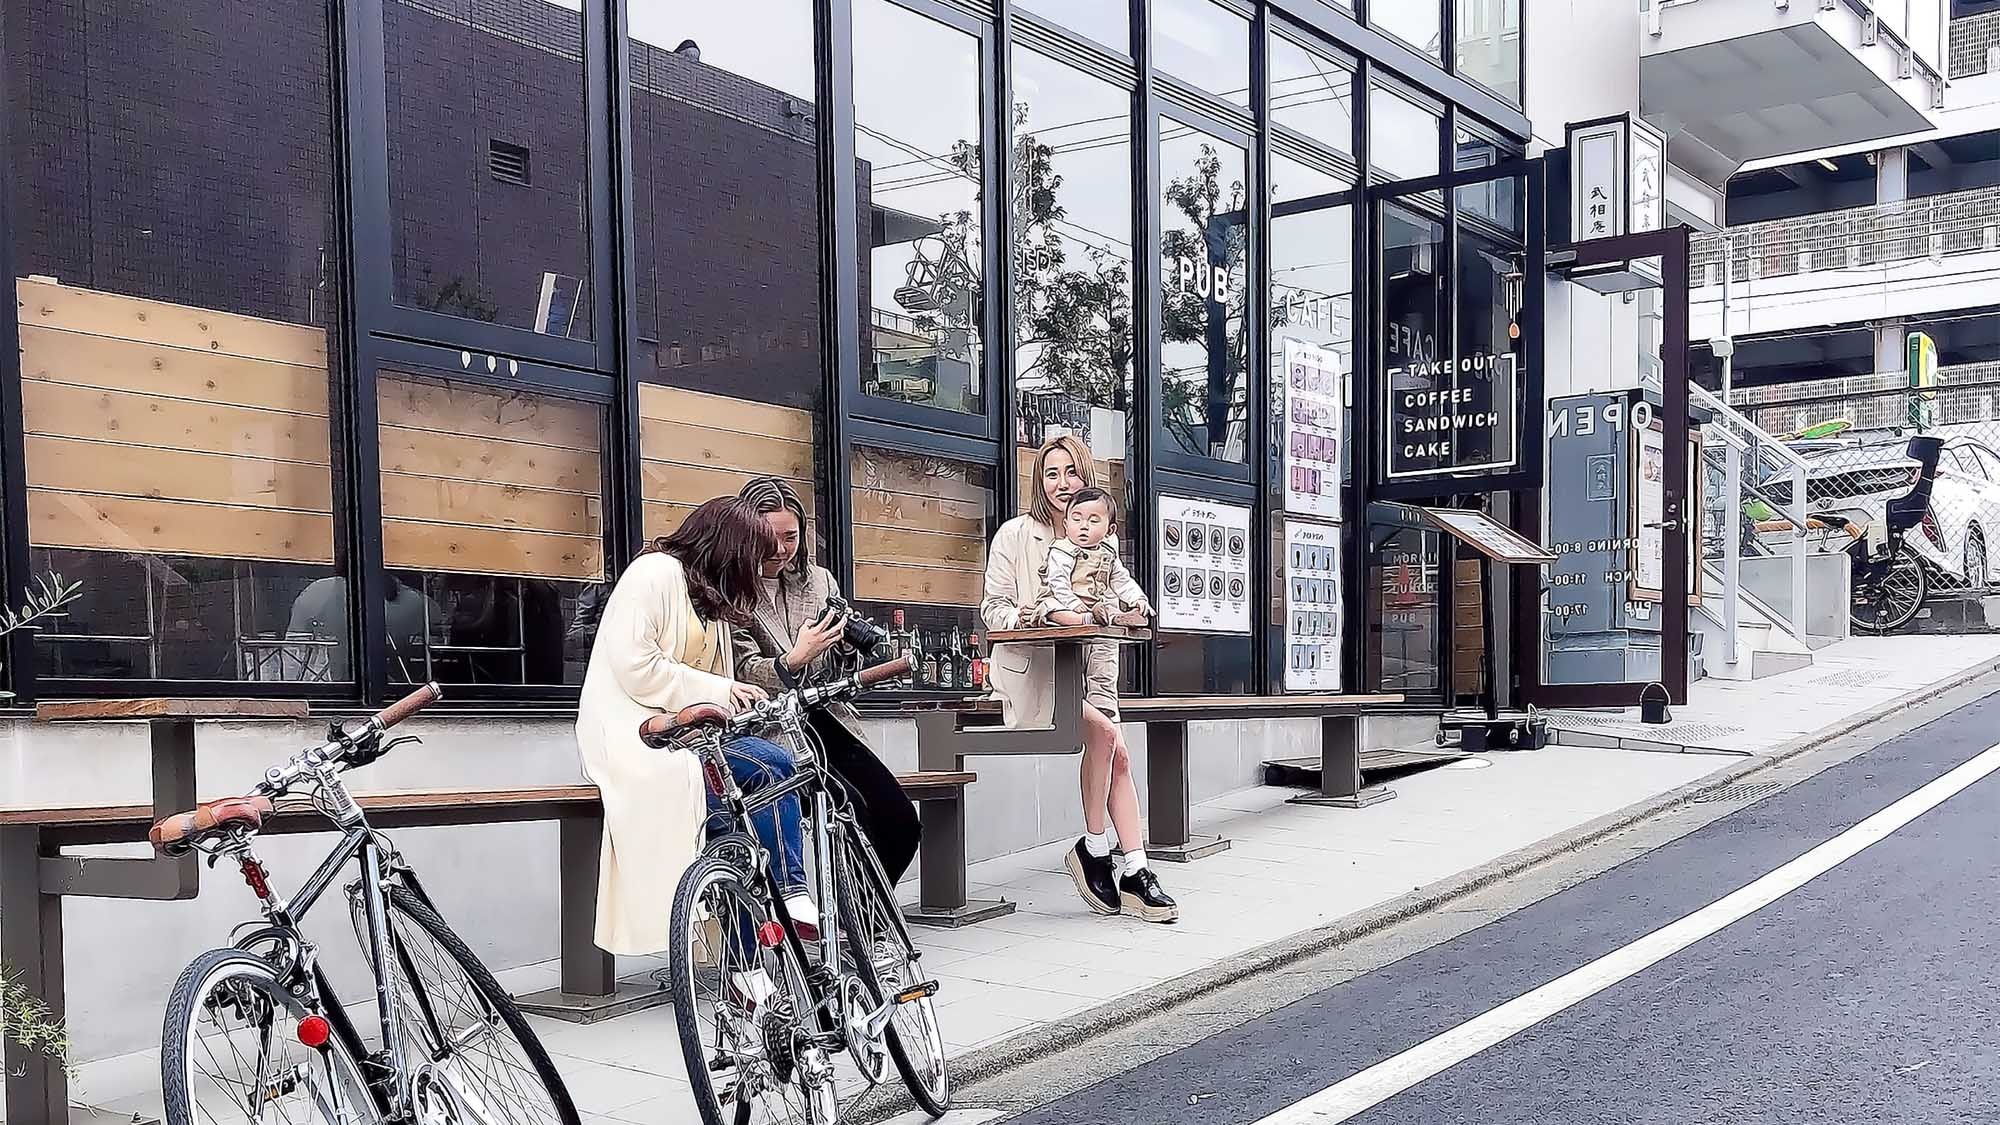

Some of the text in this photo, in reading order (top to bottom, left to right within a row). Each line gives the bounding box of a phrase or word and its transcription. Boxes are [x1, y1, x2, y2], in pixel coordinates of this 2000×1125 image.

[1180, 256, 1228, 304] PUB
[1287, 290, 1342, 337] CAFE
[1408, 360, 1453, 377] TAKE
[1461, 355, 1497, 372] OUT
[1405, 388, 1472, 408] COFFEE
[1404, 412, 1498, 433] SANDWICH
[1404, 441, 1450, 458] CAKE
